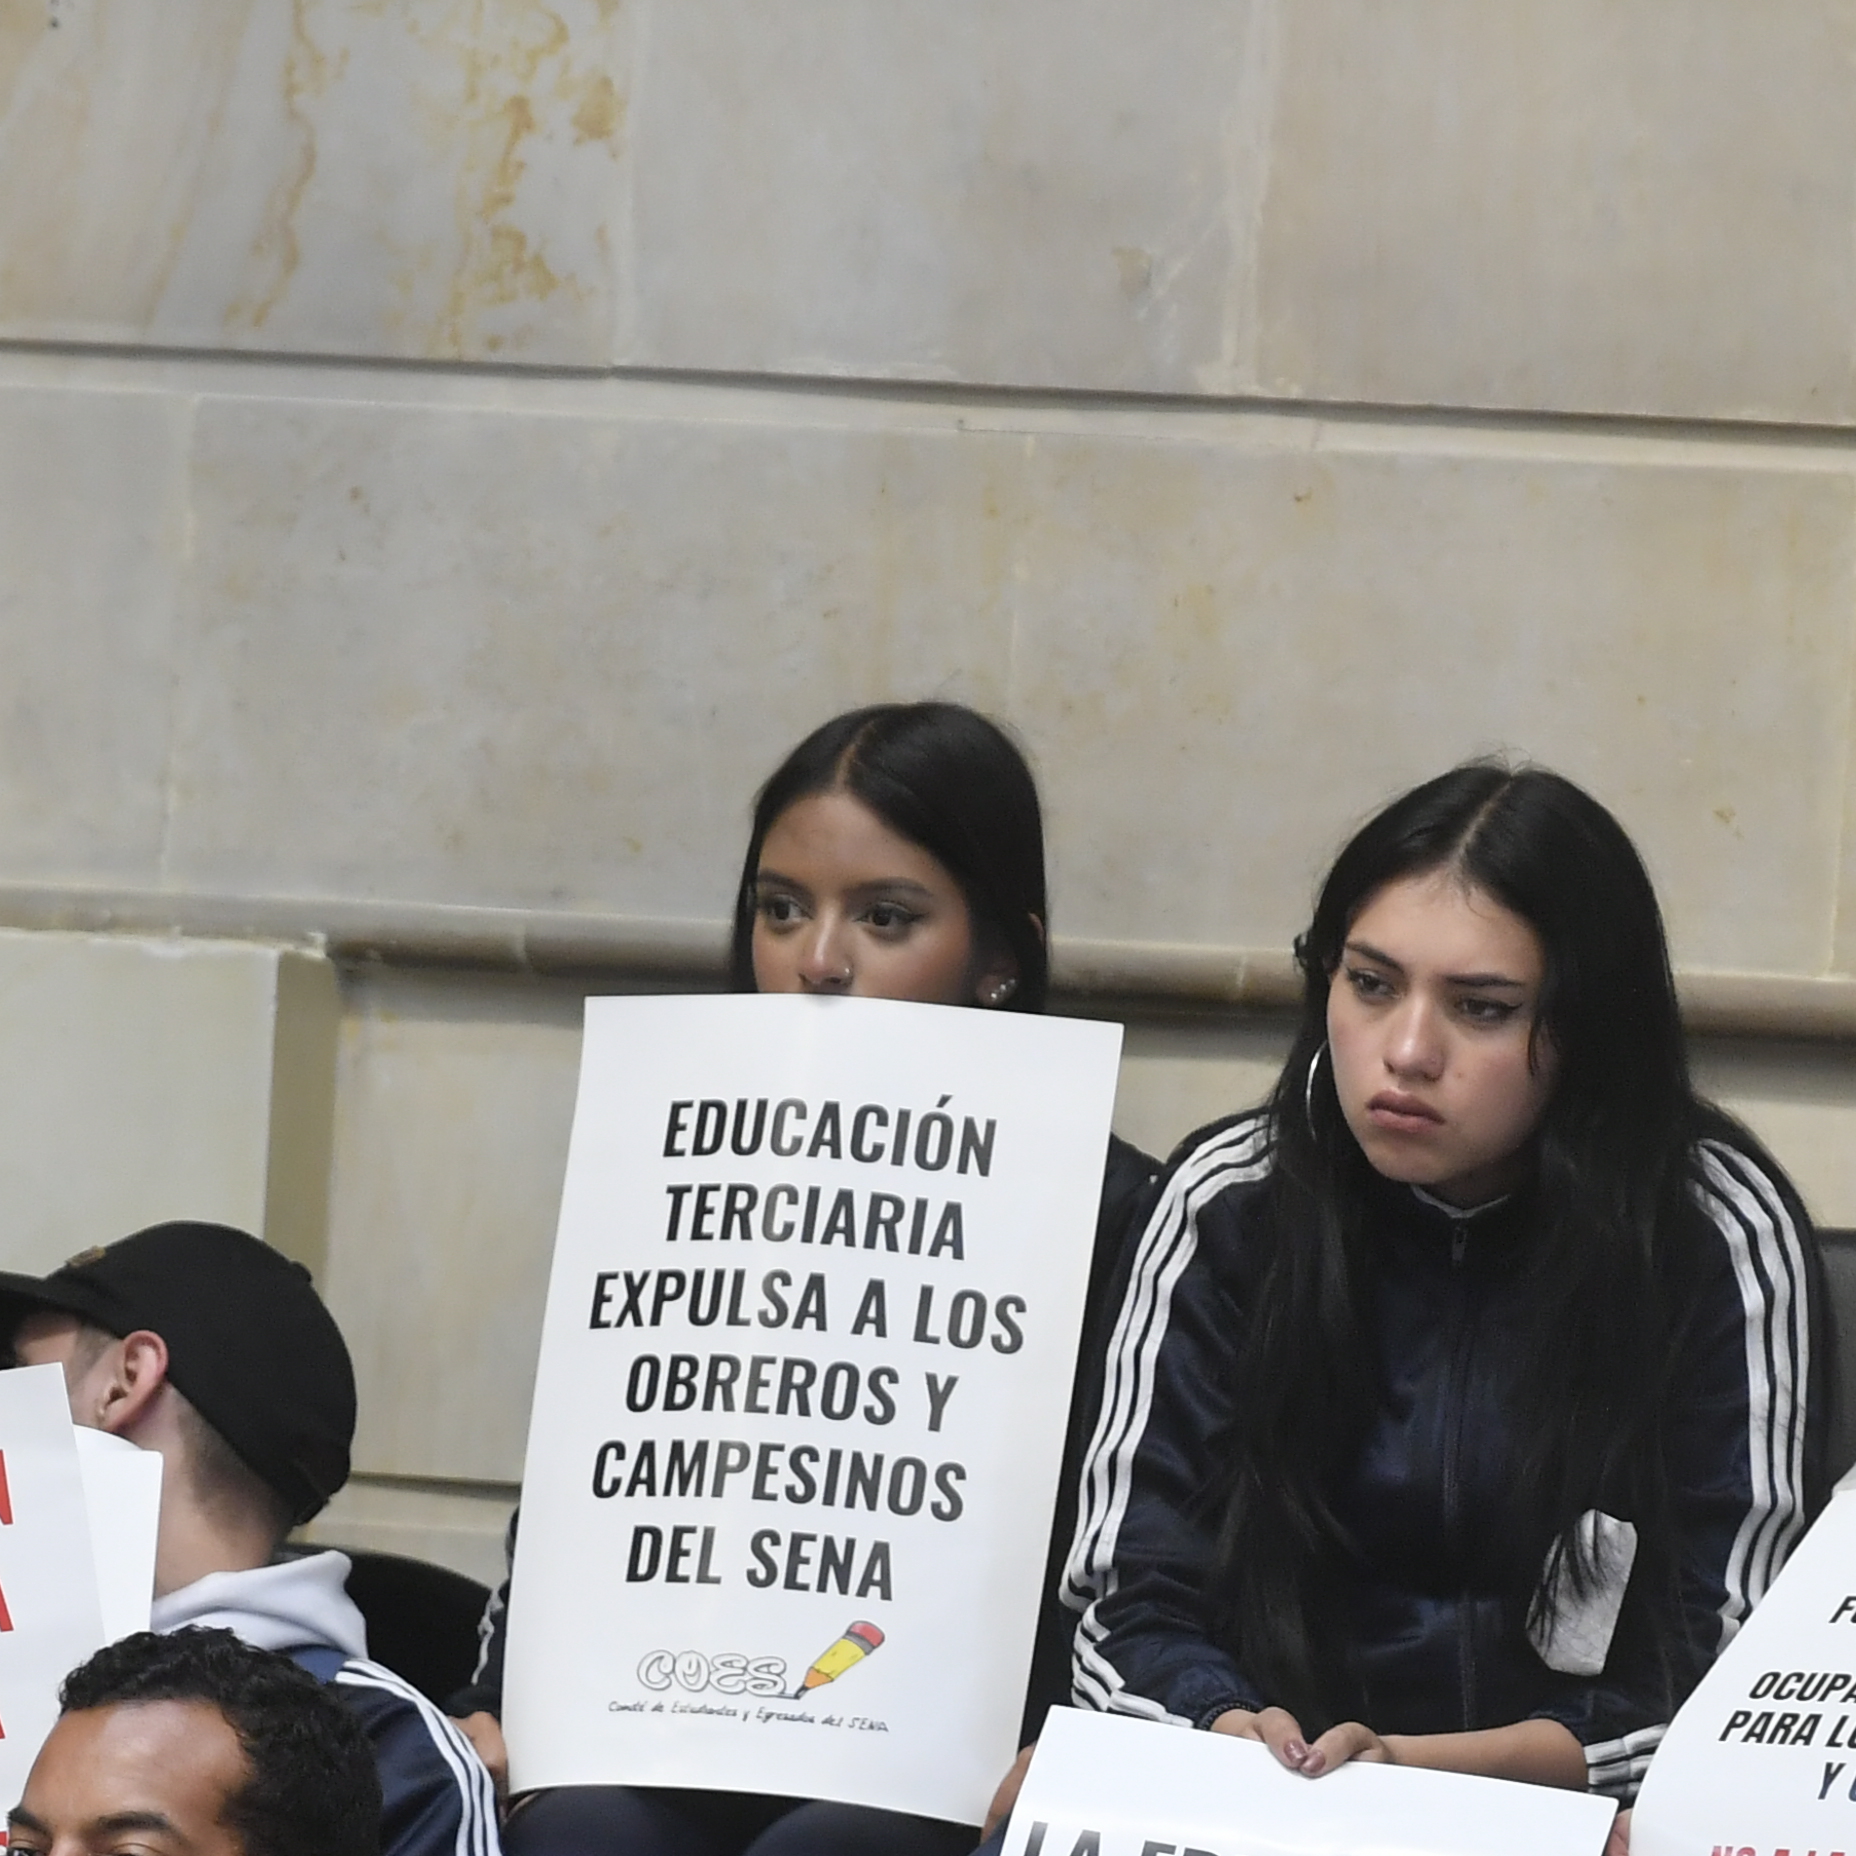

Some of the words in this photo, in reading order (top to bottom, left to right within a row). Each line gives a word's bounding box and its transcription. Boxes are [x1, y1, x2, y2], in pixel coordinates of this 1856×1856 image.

[663, 1095, 996, 1177] EDUCACIÓN
[666, 1184, 964, 1260] TERCIARIA
[589, 1269, 827, 1331] EXPULSA
[851, 1279, 887, 1338] A
[914, 1285, 1026, 1354] LOS
[626, 1355, 899, 1425] OBREROS
[926, 1373, 958, 1432] Y
[593, 1440, 966, 1521] CAMPESINOS
[626, 1526, 720, 1584] DEL
[747, 1530, 892, 1601] SENA
[637, 1649, 787, 1697] COES
[608, 1701, 645, 1712] Comité
[651, 1702, 664, 1713] de
[671, 1702, 737, 1717] Estudiantes
[756, 1707, 815, 1724] Egresados
[822, 1714, 841, 1727] del
[848, 1717, 888, 1732] SENA
[1719, 1711, 1822, 1745] PARA
[1819, 1763, 1845, 1799] Y
